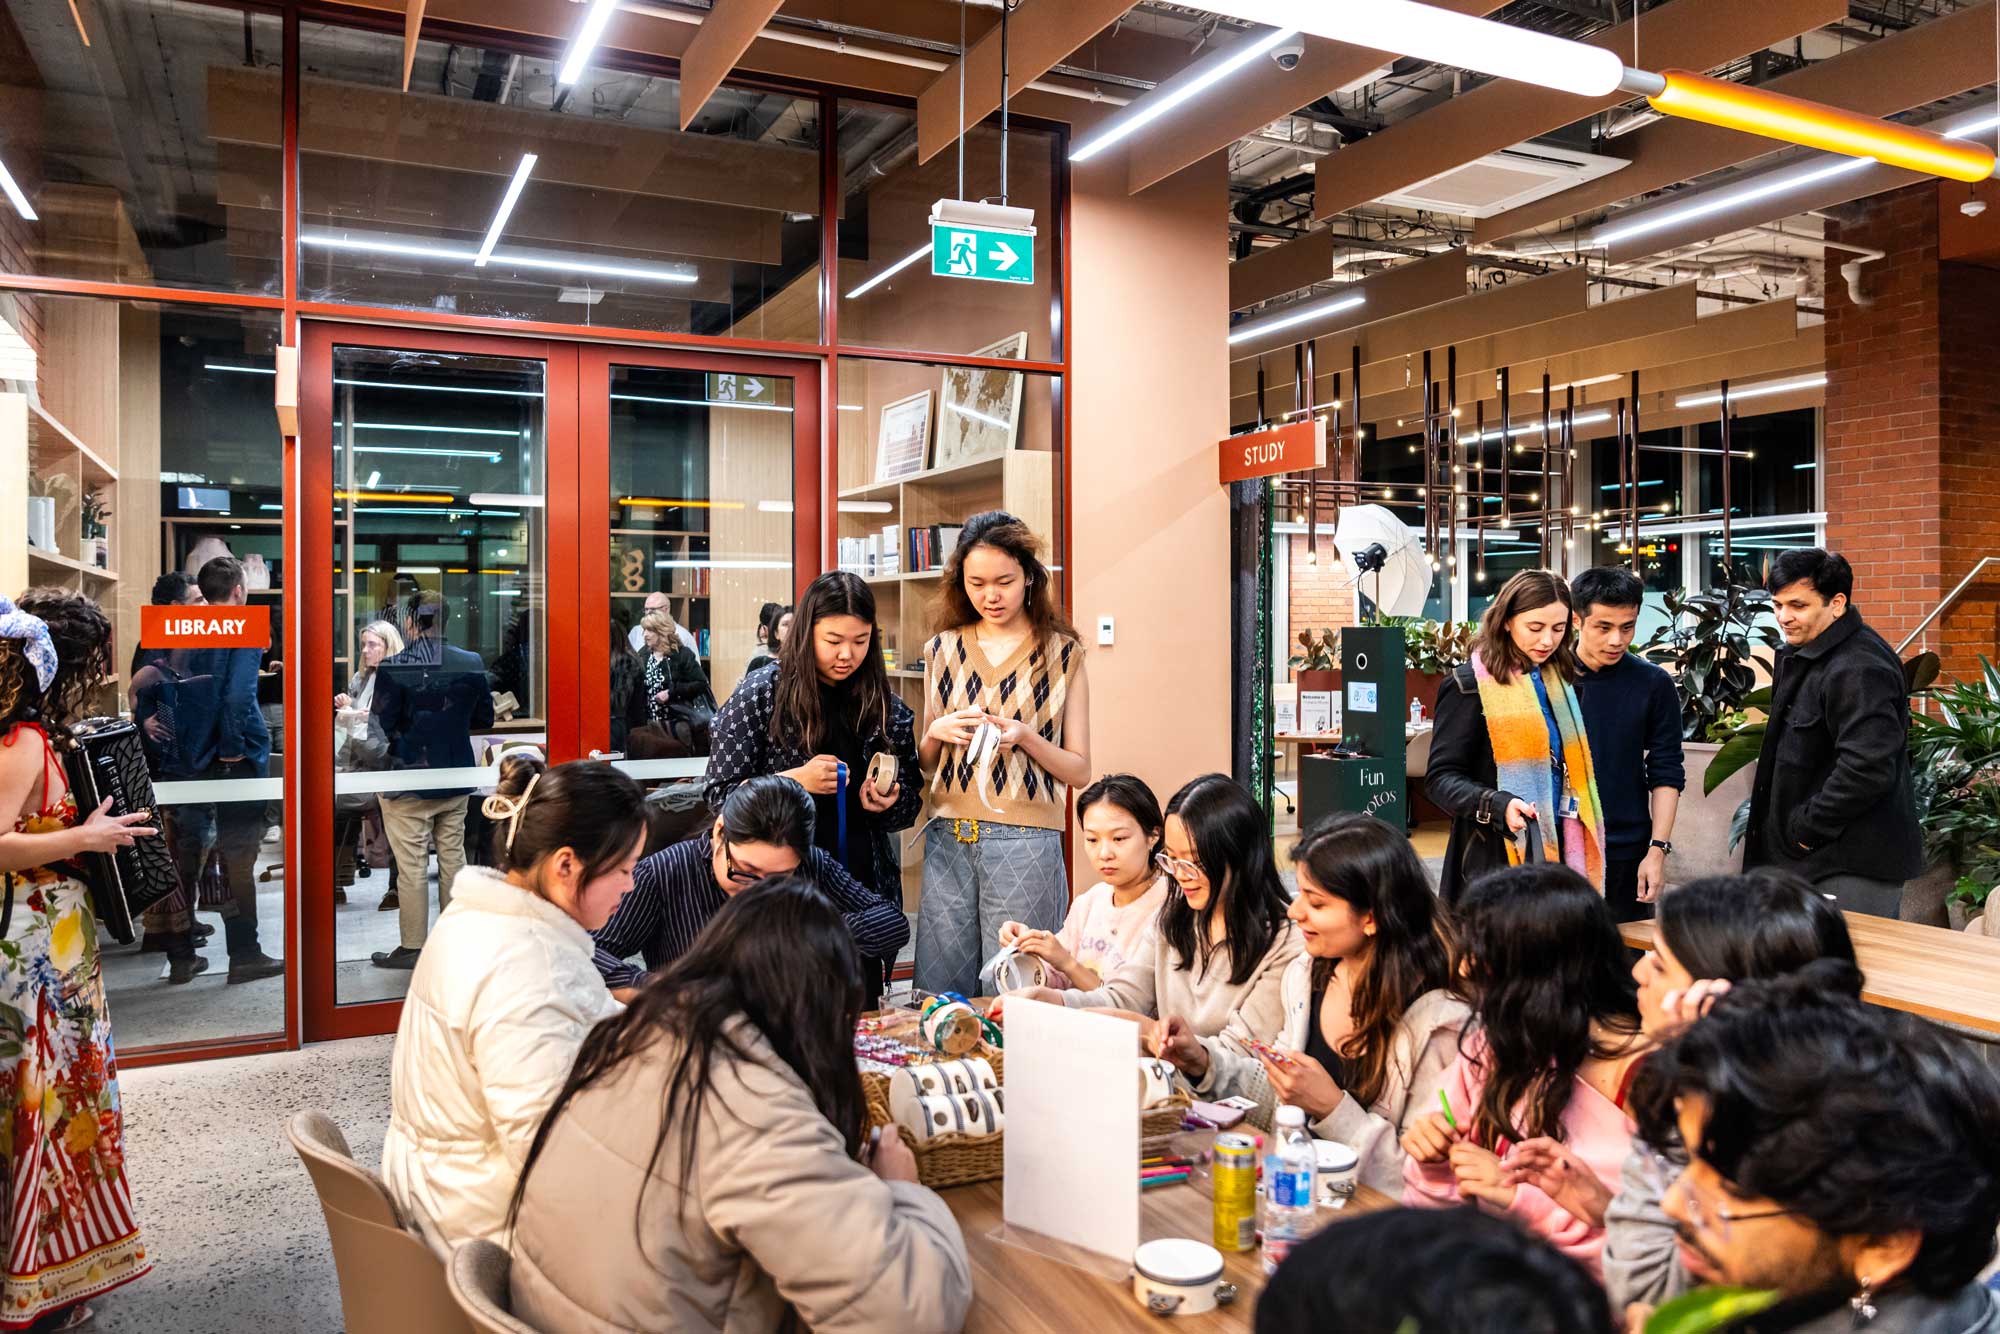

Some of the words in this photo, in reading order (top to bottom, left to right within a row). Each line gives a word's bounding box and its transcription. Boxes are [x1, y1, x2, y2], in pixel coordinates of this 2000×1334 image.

[1244, 440, 1285, 466] STUDY
[165, 619, 246, 635] LIBRARY
[1360, 768, 1384, 787] Fun
[1362, 790, 1397, 817] otos
